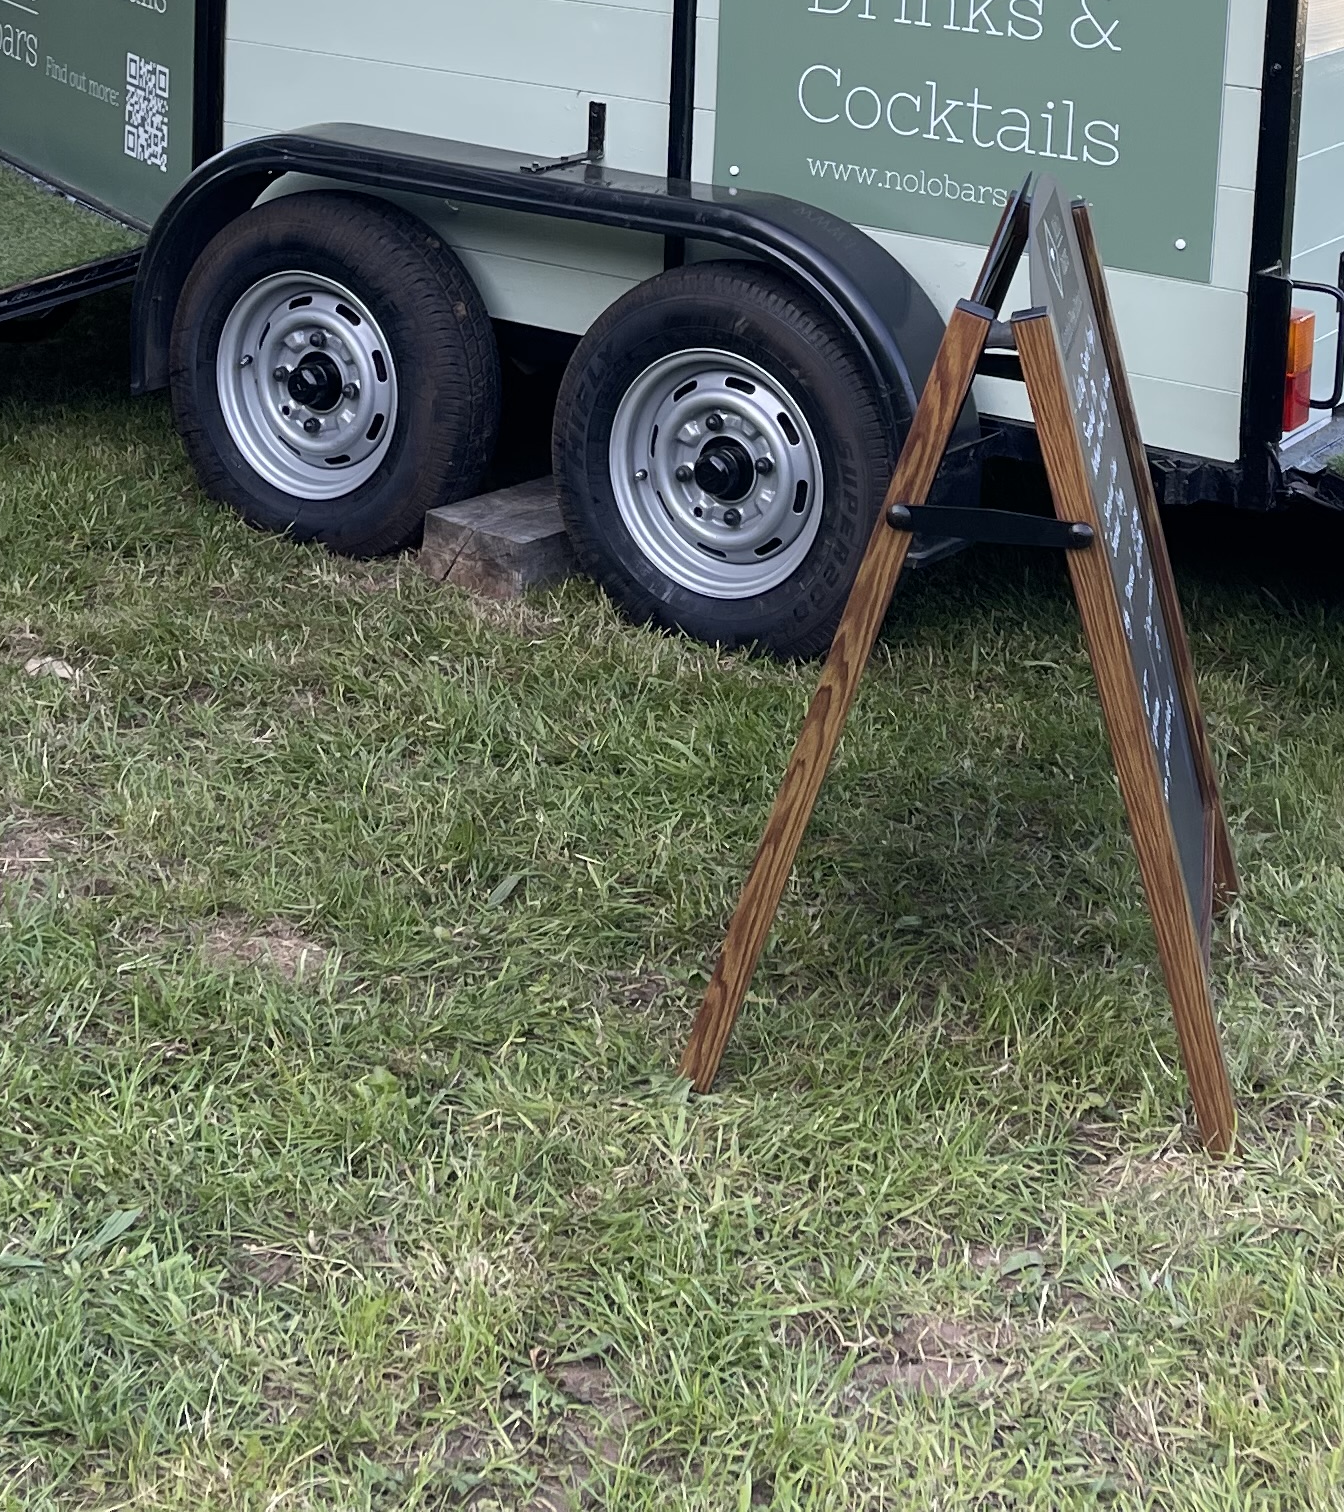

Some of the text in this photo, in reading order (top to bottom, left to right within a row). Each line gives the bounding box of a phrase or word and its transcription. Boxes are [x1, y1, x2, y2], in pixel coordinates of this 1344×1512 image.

[45, 55, 67, 84] Find
[69, 70, 87, 93] out
[799, 64, 1120, 166] Cocktails
[807, 158, 1093, 207] www.nolobars
